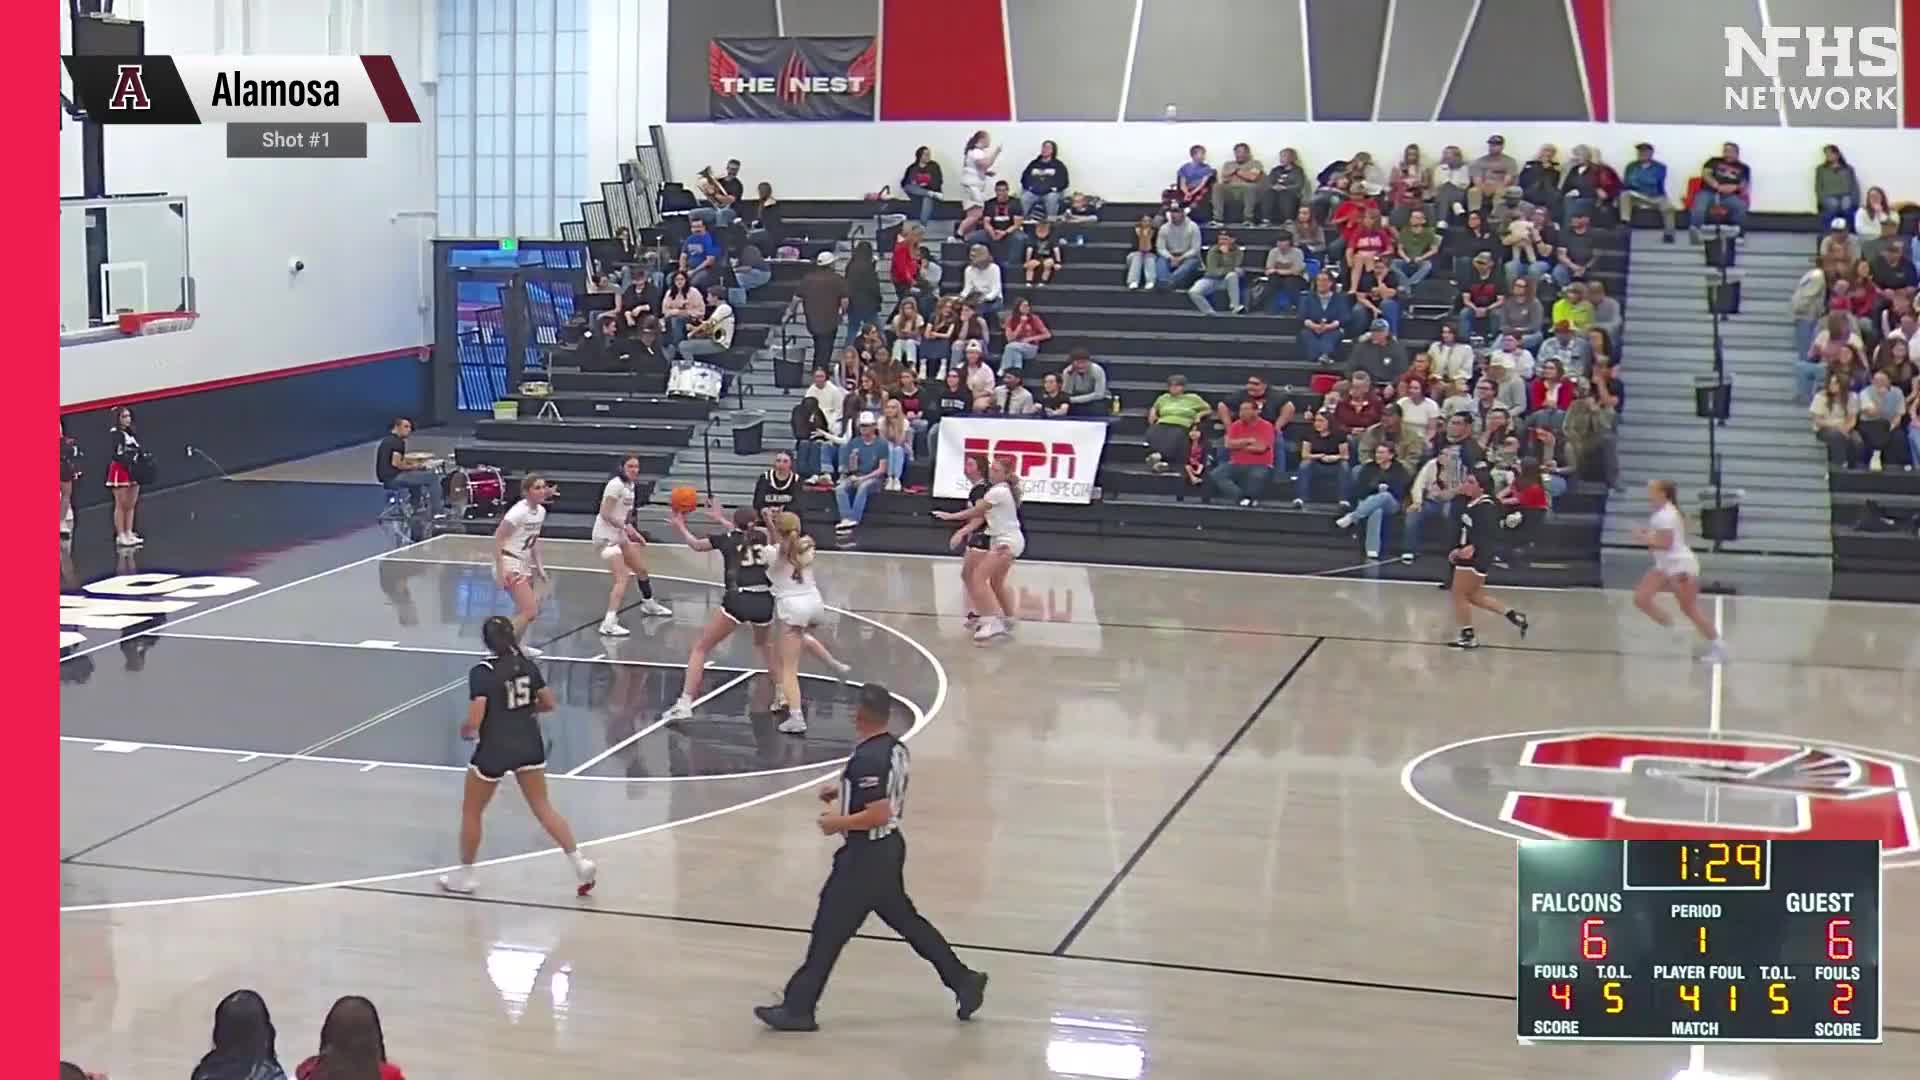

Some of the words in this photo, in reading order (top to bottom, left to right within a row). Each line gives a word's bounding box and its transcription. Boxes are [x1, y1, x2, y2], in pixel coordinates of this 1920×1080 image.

[720, 77, 775, 93] THE
[789, 76, 865, 93] NEST
[505, 676, 531, 710] 15
